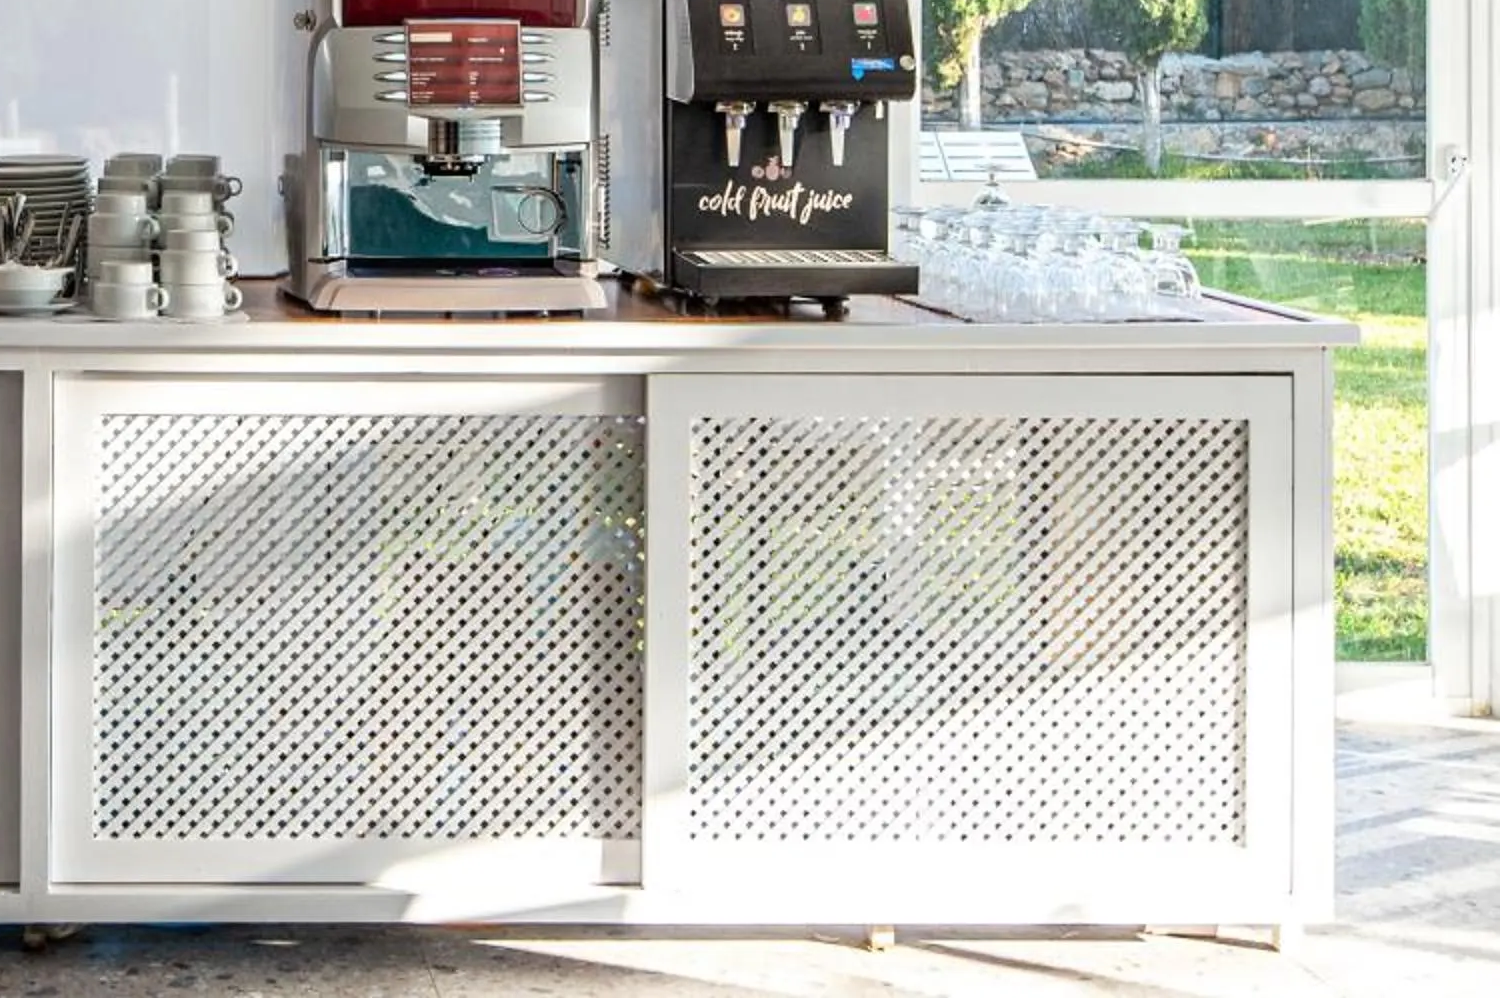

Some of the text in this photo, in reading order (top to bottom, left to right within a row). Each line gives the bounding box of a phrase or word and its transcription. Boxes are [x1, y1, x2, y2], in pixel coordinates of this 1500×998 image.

[699, 179, 853, 225] cold fruit juice
